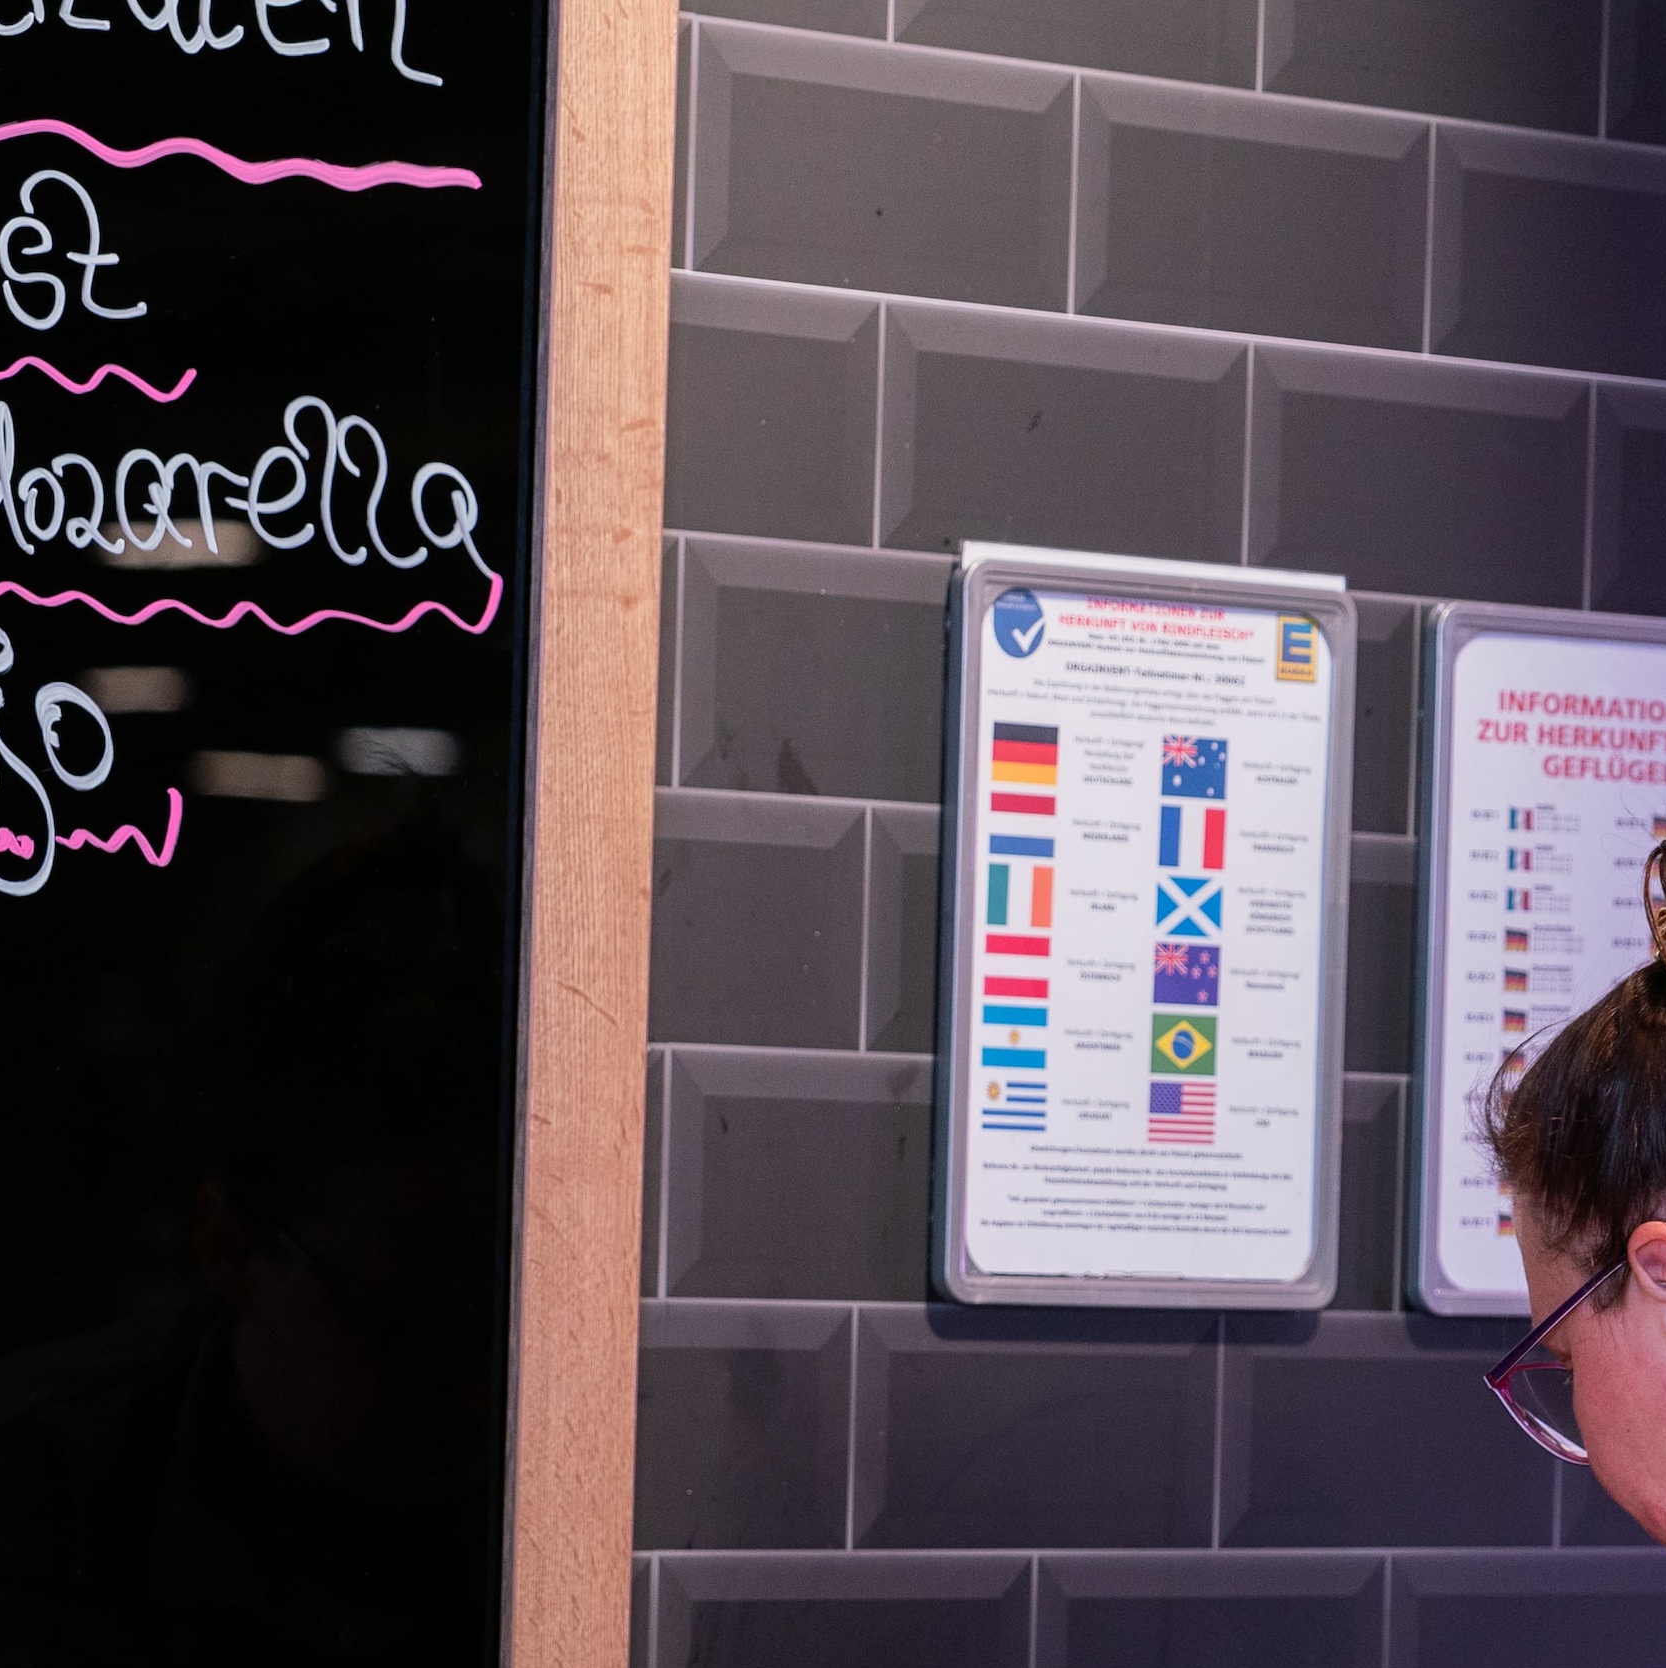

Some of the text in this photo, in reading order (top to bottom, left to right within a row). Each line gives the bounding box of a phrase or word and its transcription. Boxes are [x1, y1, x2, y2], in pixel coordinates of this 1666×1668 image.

[1086, 597, 1196, 619] INFORMATIONEN
[1059, 613, 1126, 630] HERKUNFT
[1131, 619, 1158, 633] VON
[1476, 718, 1530, 744] ZUR
